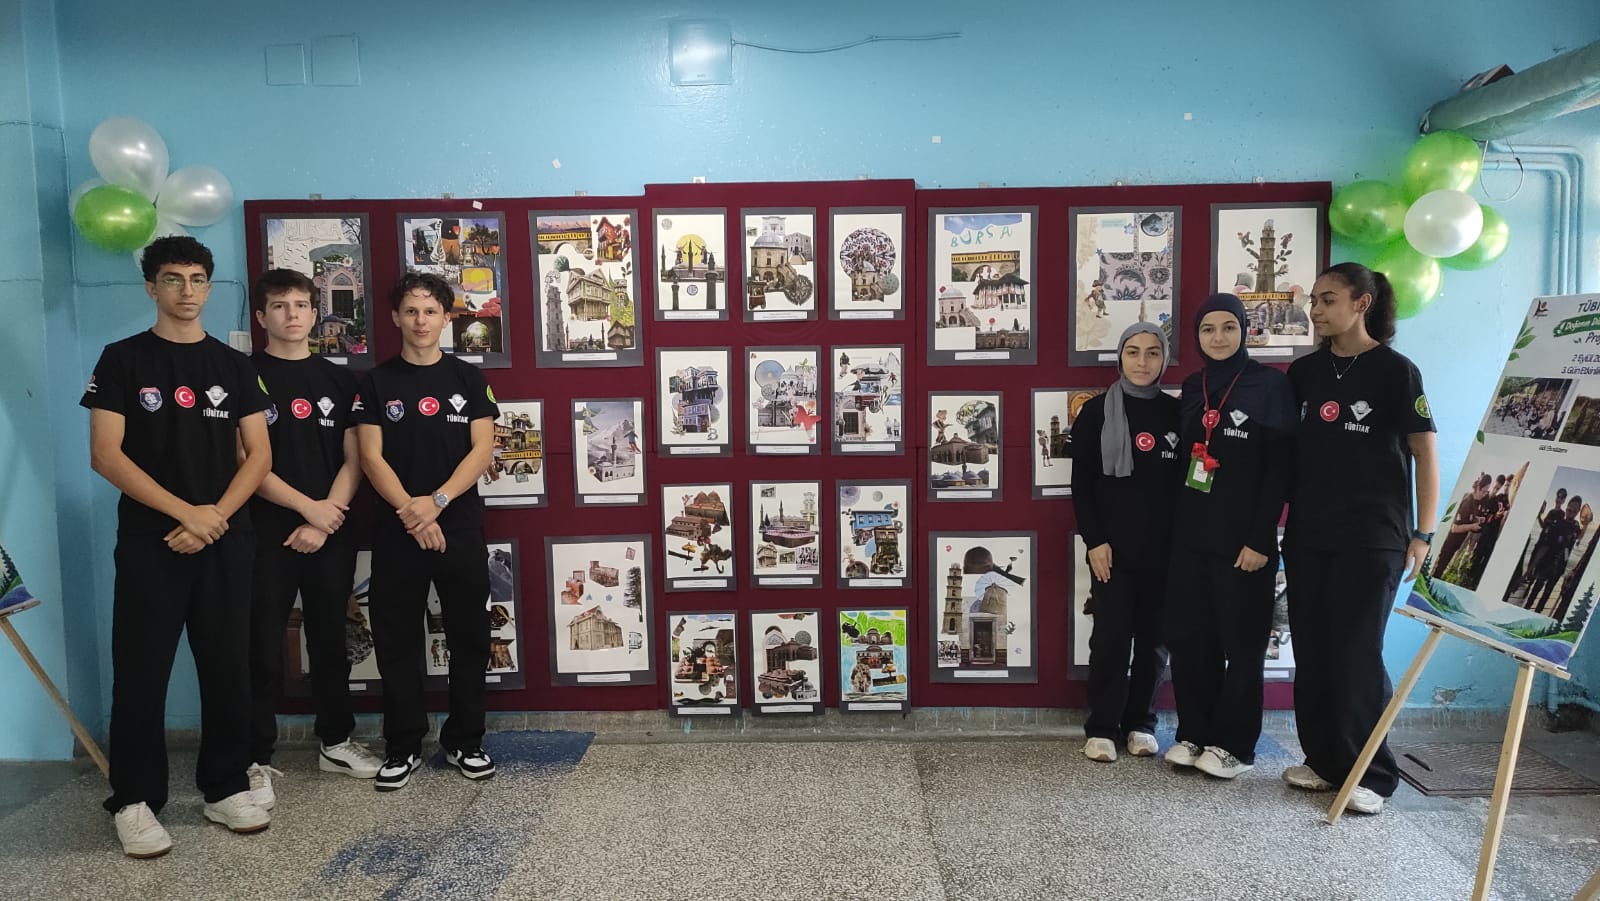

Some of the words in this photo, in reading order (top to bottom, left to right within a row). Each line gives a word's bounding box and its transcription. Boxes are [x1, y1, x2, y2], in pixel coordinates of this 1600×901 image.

[951, 225, 1013, 247] BURSA
[203, 408, 229, 418] TÜBİTAK
[446, 414, 469, 423] TÜBİTAK
[1223, 427, 1248, 439] TÜBİTAK
[1343, 422, 1370, 433] TÜBİTAK
